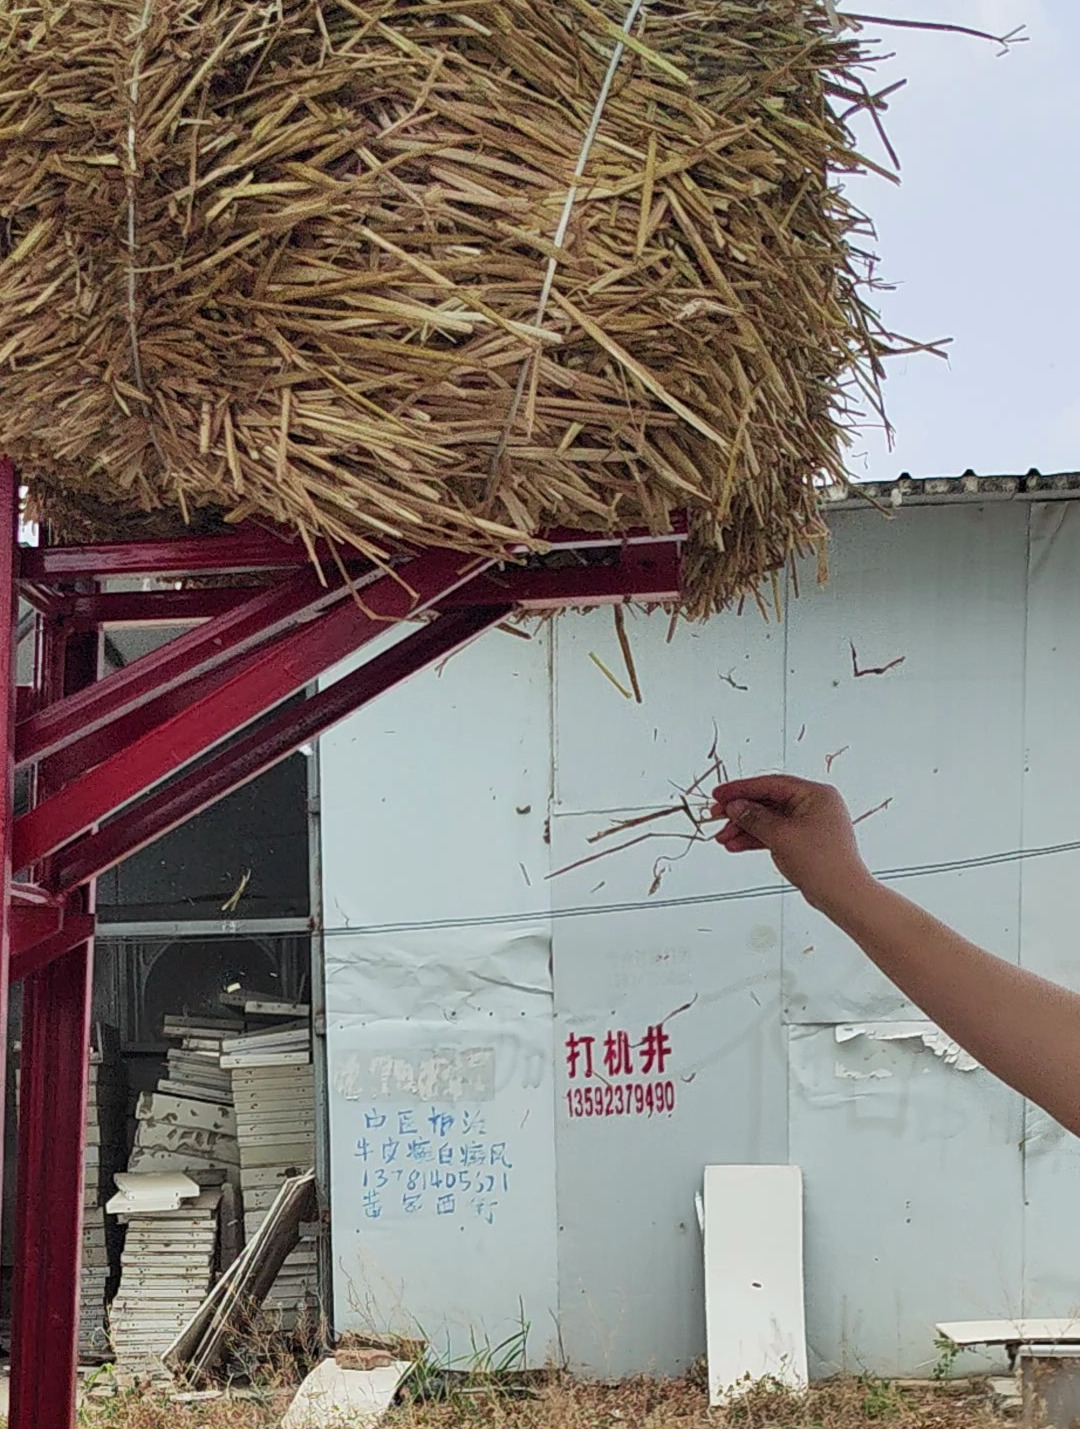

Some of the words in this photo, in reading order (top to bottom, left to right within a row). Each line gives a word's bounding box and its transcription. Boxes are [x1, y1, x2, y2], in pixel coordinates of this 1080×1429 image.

[565, 1025, 672, 1078] 打机井
[566, 1081, 674, 1117] 13592379490
